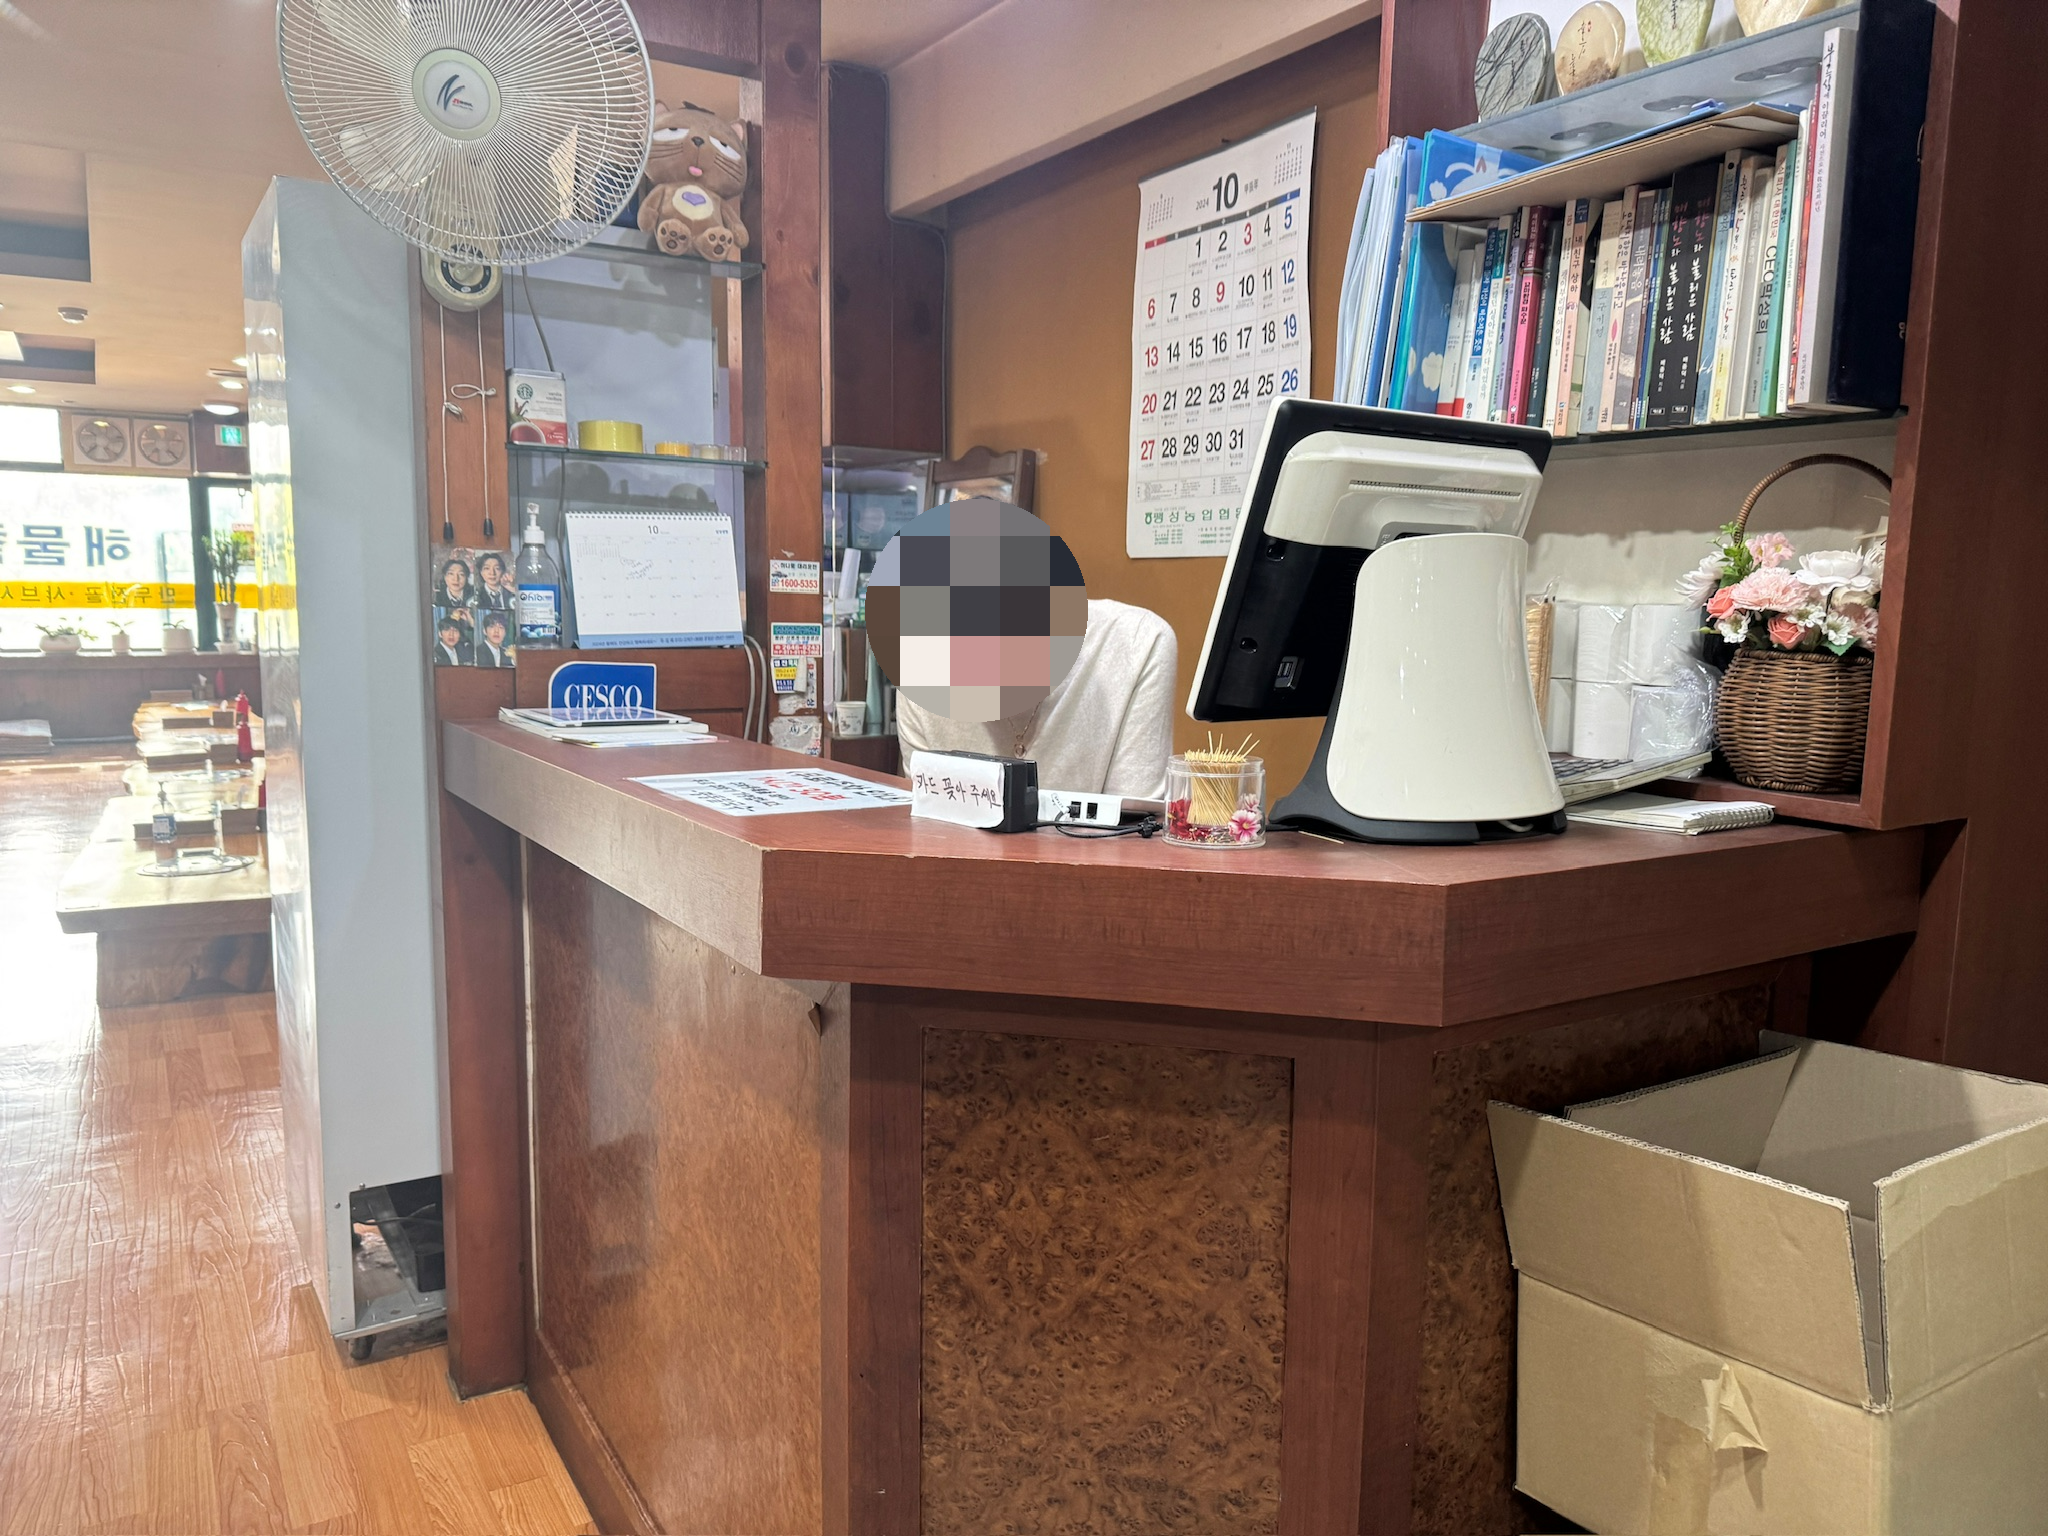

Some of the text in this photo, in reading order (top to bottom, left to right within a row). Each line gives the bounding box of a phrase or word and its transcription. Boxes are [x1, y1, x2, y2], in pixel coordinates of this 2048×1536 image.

[1195, 197, 1209, 211] 2024
[1213, 173, 1238, 212] 10
[1196, 205, 1292, 258] 1 2 3 4 5
[1769, 199, 1781, 239] 대한민국
[1569, 234, 1583, 293] 내 친구 상하
[1631, 243, 1647, 291] 내려놓음
[1687, 257, 1703, 308] 불리운
[1148, 259, 1294, 319] 6 7 8 9 10 11 12
[1665, 260, 1680, 313] 불리운
[1145, 314, 1297, 367] 13 14 15 16 17 18 19
[1658, 315, 1674, 346] 사람
[1681, 313, 1697, 343] 사람
[1142, 368, 1298, 414] 20 21 22 23 24 25 26
[1141, 428, 1243, 460] 27 28 29 30 31
[648, 525, 659, 535] 10
[780, 579, 818, 589] 1600-5353
[563, 684, 643, 709] CESCO
[916, 772, 940, 796] 카드
[942, 777, 966, 803] 꽂아
[970, 784, 1002, 809] 주세요
